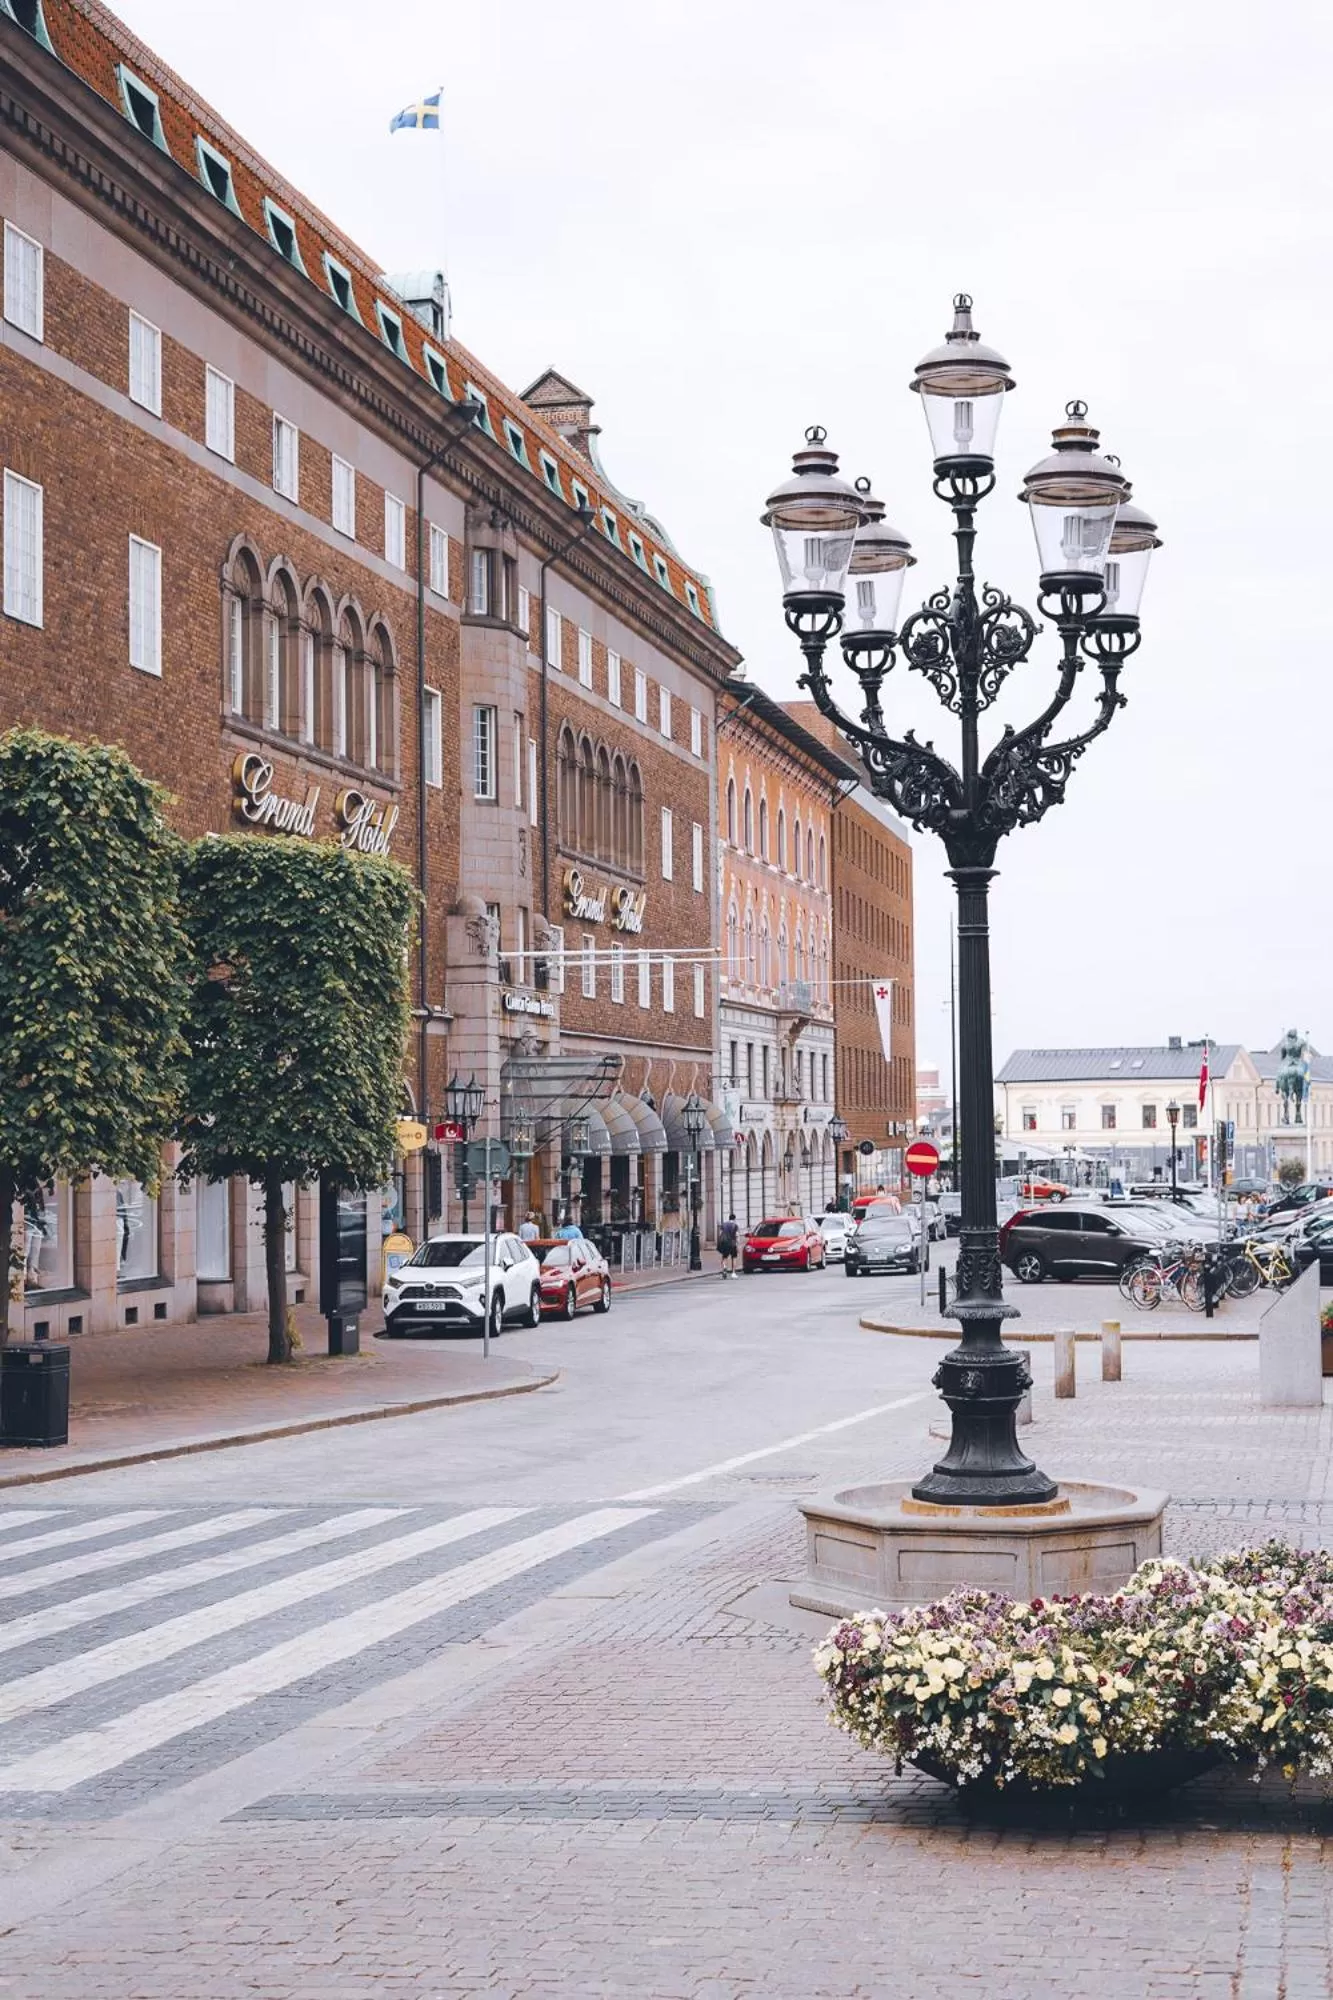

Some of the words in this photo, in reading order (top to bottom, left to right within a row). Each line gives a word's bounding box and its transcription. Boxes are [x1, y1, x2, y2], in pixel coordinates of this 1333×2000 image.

[240, 752, 321, 836] Grand
[340, 789, 399, 857] Hotel
[568, 868, 607, 922] Grand
[616, 886, 646, 934] Hotel
